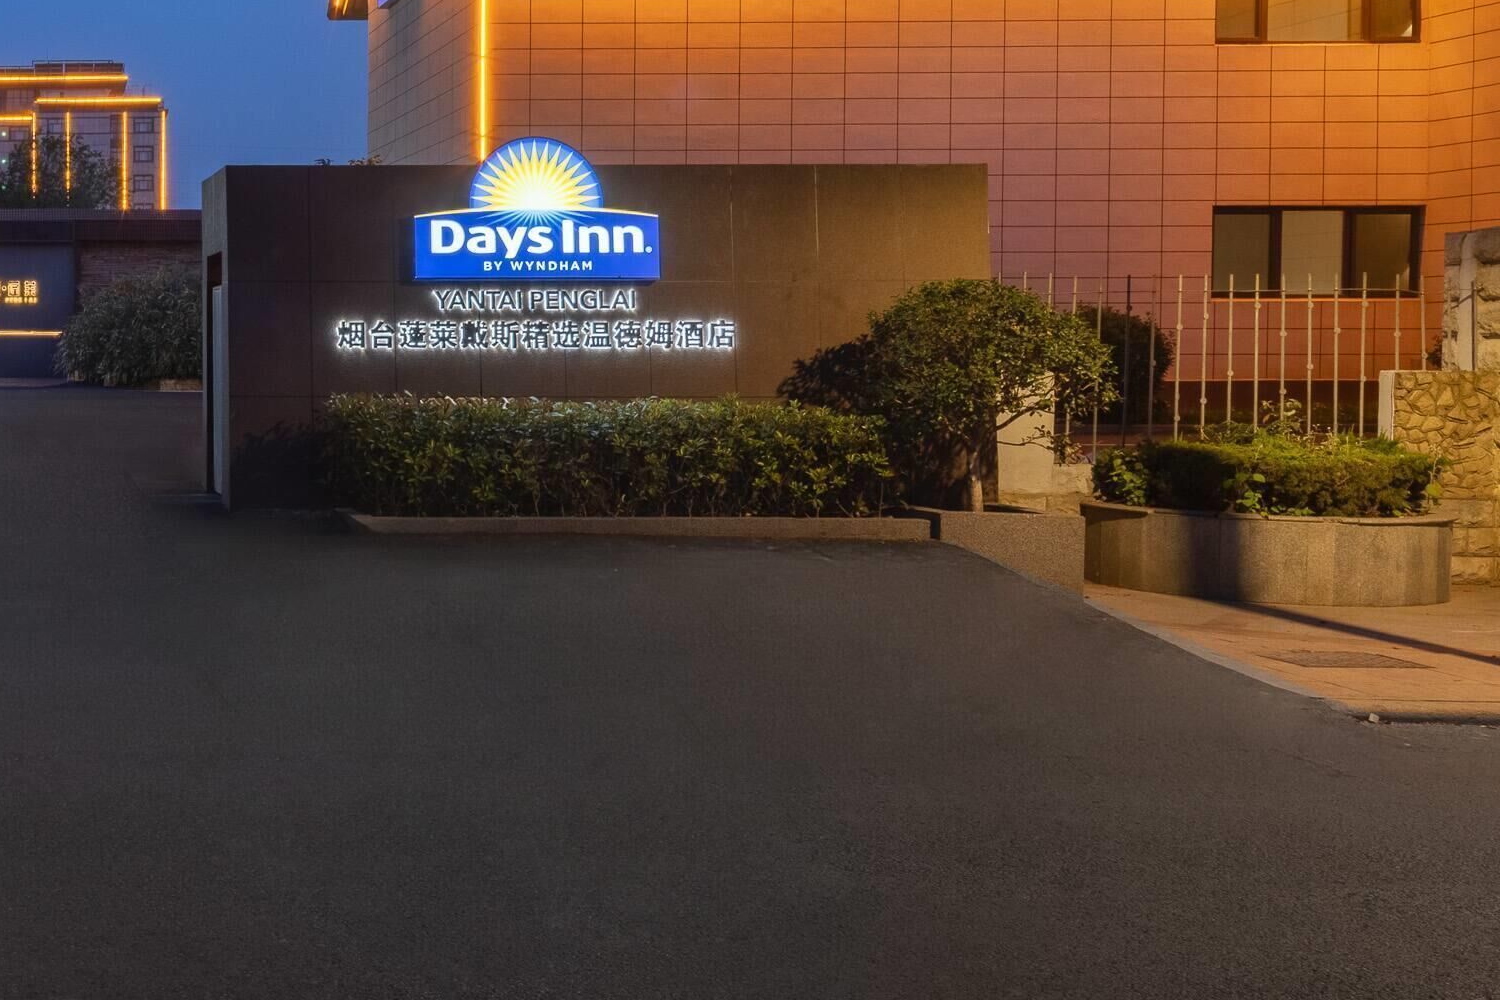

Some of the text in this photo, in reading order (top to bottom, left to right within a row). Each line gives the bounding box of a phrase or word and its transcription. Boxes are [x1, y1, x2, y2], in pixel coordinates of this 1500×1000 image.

[430, 219, 553, 259] Days
[483, 260, 593, 272] BY WYNDHAM
[434, 289, 637, 310] YANTAI PENGLAI
[337, 320, 736, 350] 烟台蓬莱戴斯精选温德姆酒店
